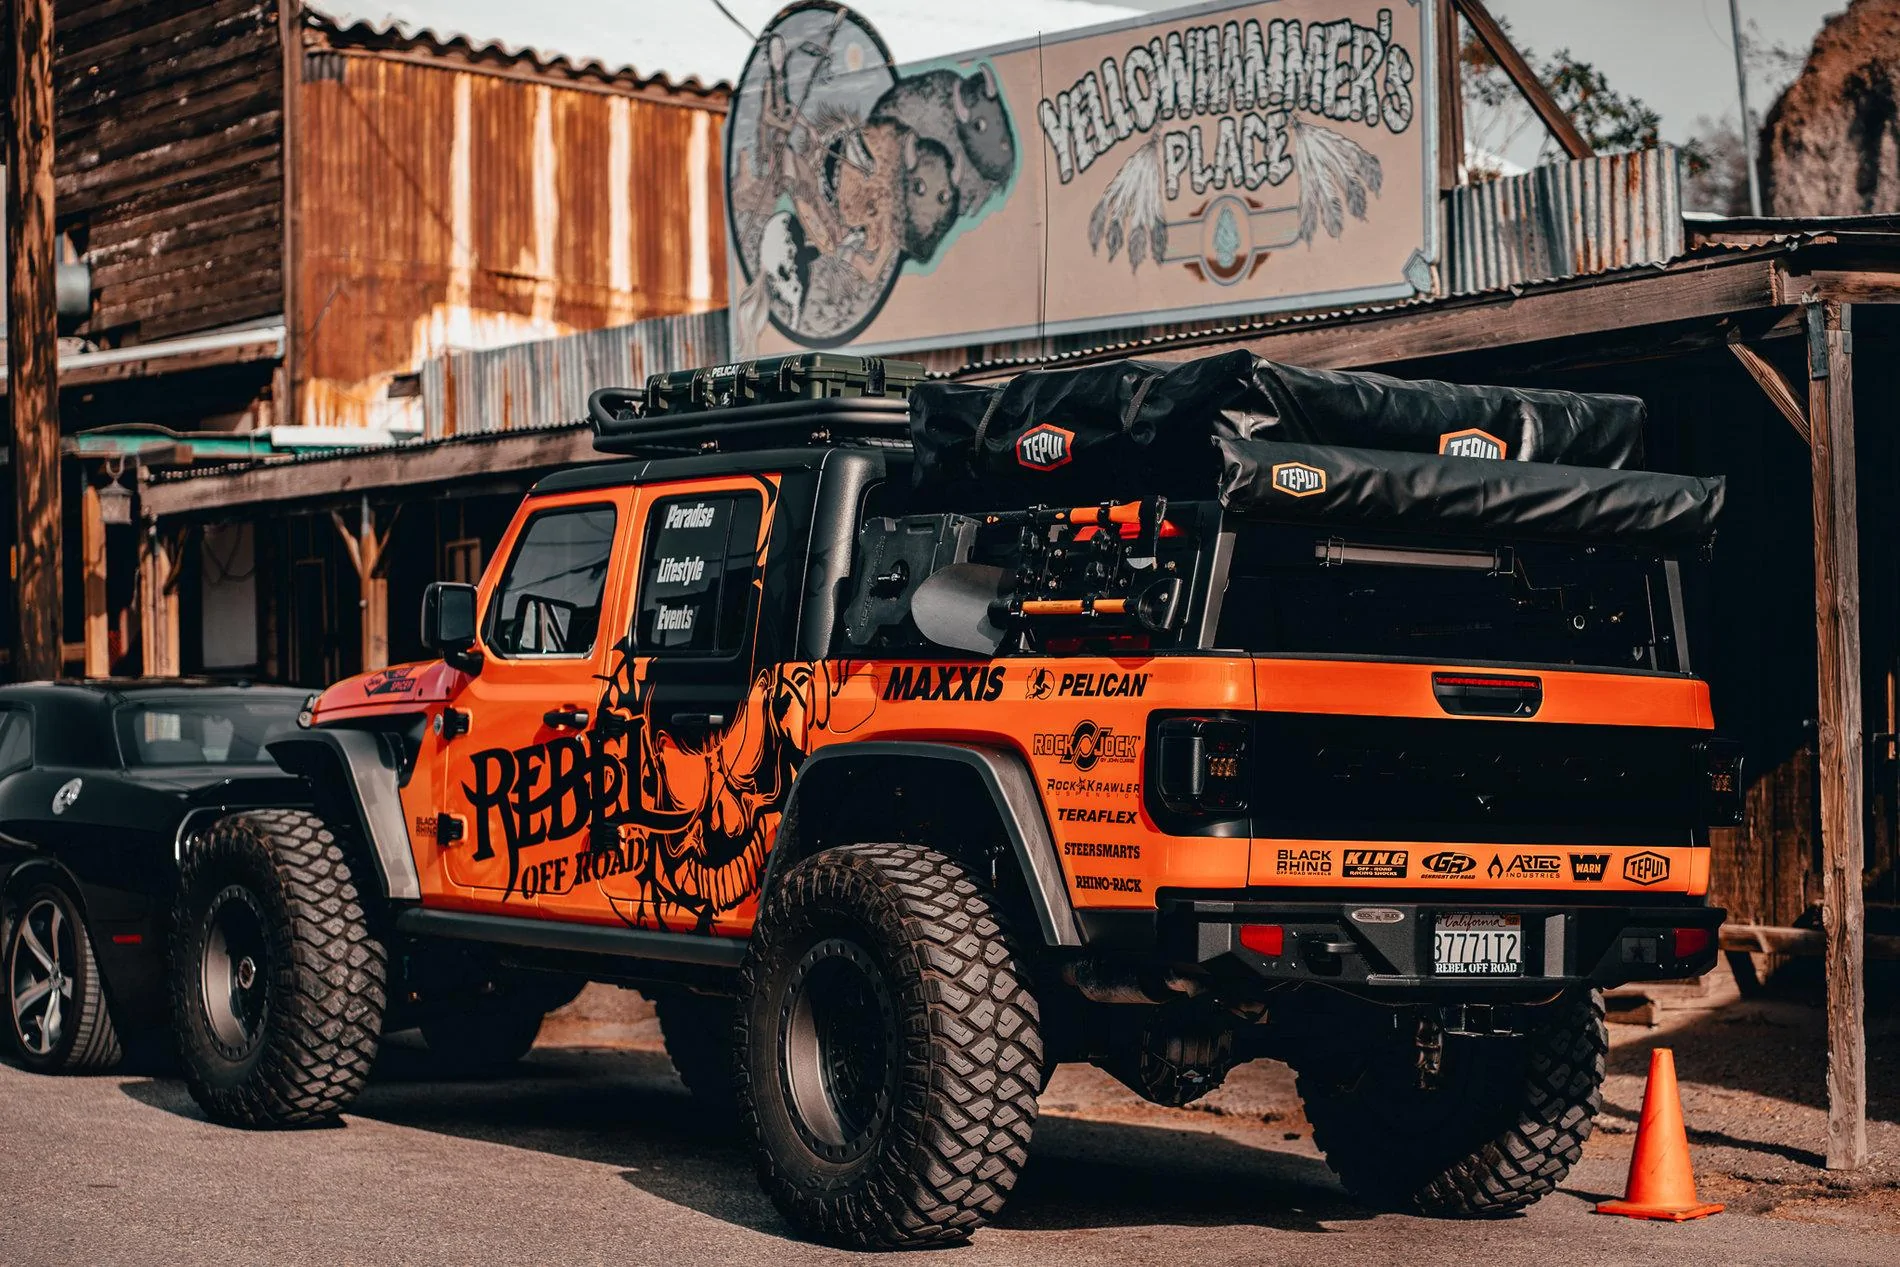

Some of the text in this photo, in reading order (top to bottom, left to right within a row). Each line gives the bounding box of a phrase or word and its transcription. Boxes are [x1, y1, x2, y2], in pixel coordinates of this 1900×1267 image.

[1037, 8, 1415, 184] YELLOWHAMMER'S
[1163, 110, 1296, 201] PLACE
[1023, 432, 1063, 463] TEPUI
[1280, 468, 1319, 490] TEPUI
[664, 502, 715, 529] Paradise
[656, 556, 704, 586] Lifestyle
[656, 604, 693, 630] Events
[883, 666, 1007, 701] MAXXIS
[1058, 673, 1149, 697] PELICAN
[1086, 780, 1140, 793] KRAWLER
[461, 716, 698, 902] REBEL
[1057, 808, 1138, 824] TERAFLEX
[1064, 842, 1141, 859] STEERSMARTS
[1278, 849, 1332, 860] BLACK
[1345, 851, 1407, 865] KING
[521, 836, 646, 899] OFF ROAD
[1277, 860, 1332, 871] RHINO
[1506, 855, 1561, 872] ARTEC
[1576, 863, 1601, 873] WARN
[1630, 857, 1664, 879] TEPUI
[1075, 875, 1142, 892] RHINO-RACK
[1441, 914, 1506, 931] California
[1435, 962, 1517, 973] REBEL OFF ROAD
